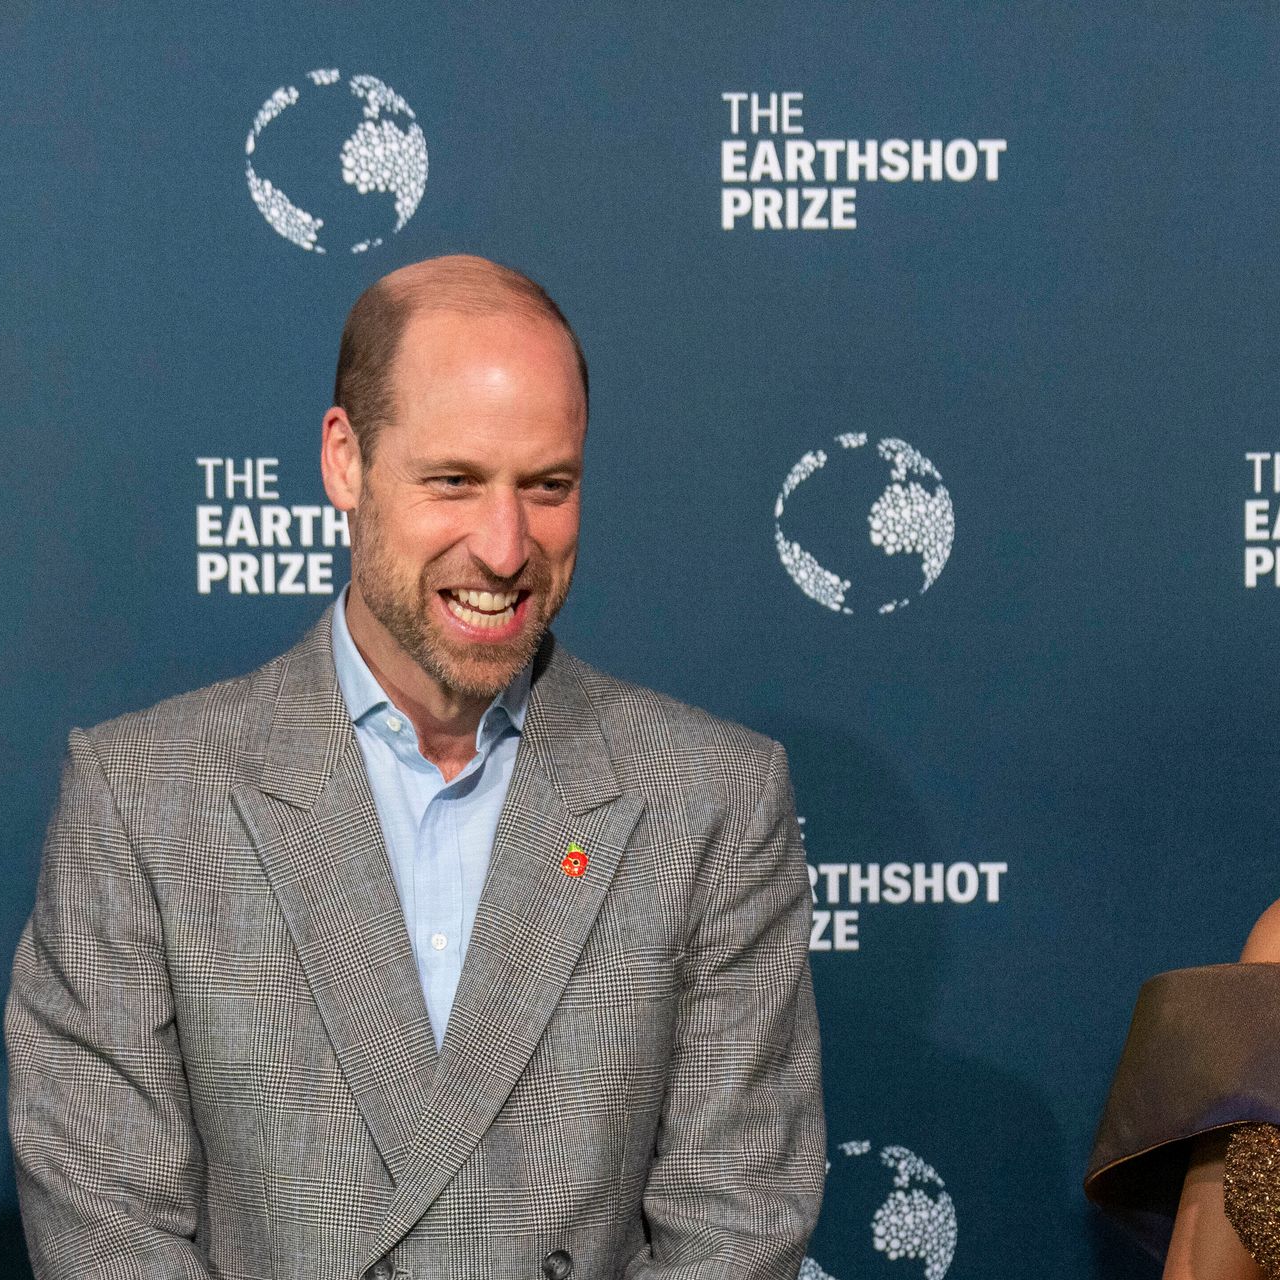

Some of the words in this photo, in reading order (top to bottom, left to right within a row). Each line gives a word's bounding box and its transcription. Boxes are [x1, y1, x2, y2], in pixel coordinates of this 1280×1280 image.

[721, 91, 804, 135] THE
[721, 138, 1007, 182] EARTHSHOT
[721, 187, 857, 230] PRIZE
[196, 457, 280, 500] THE
[196, 505, 352, 547] EARTH
[197, 552, 334, 595] PRIZE
